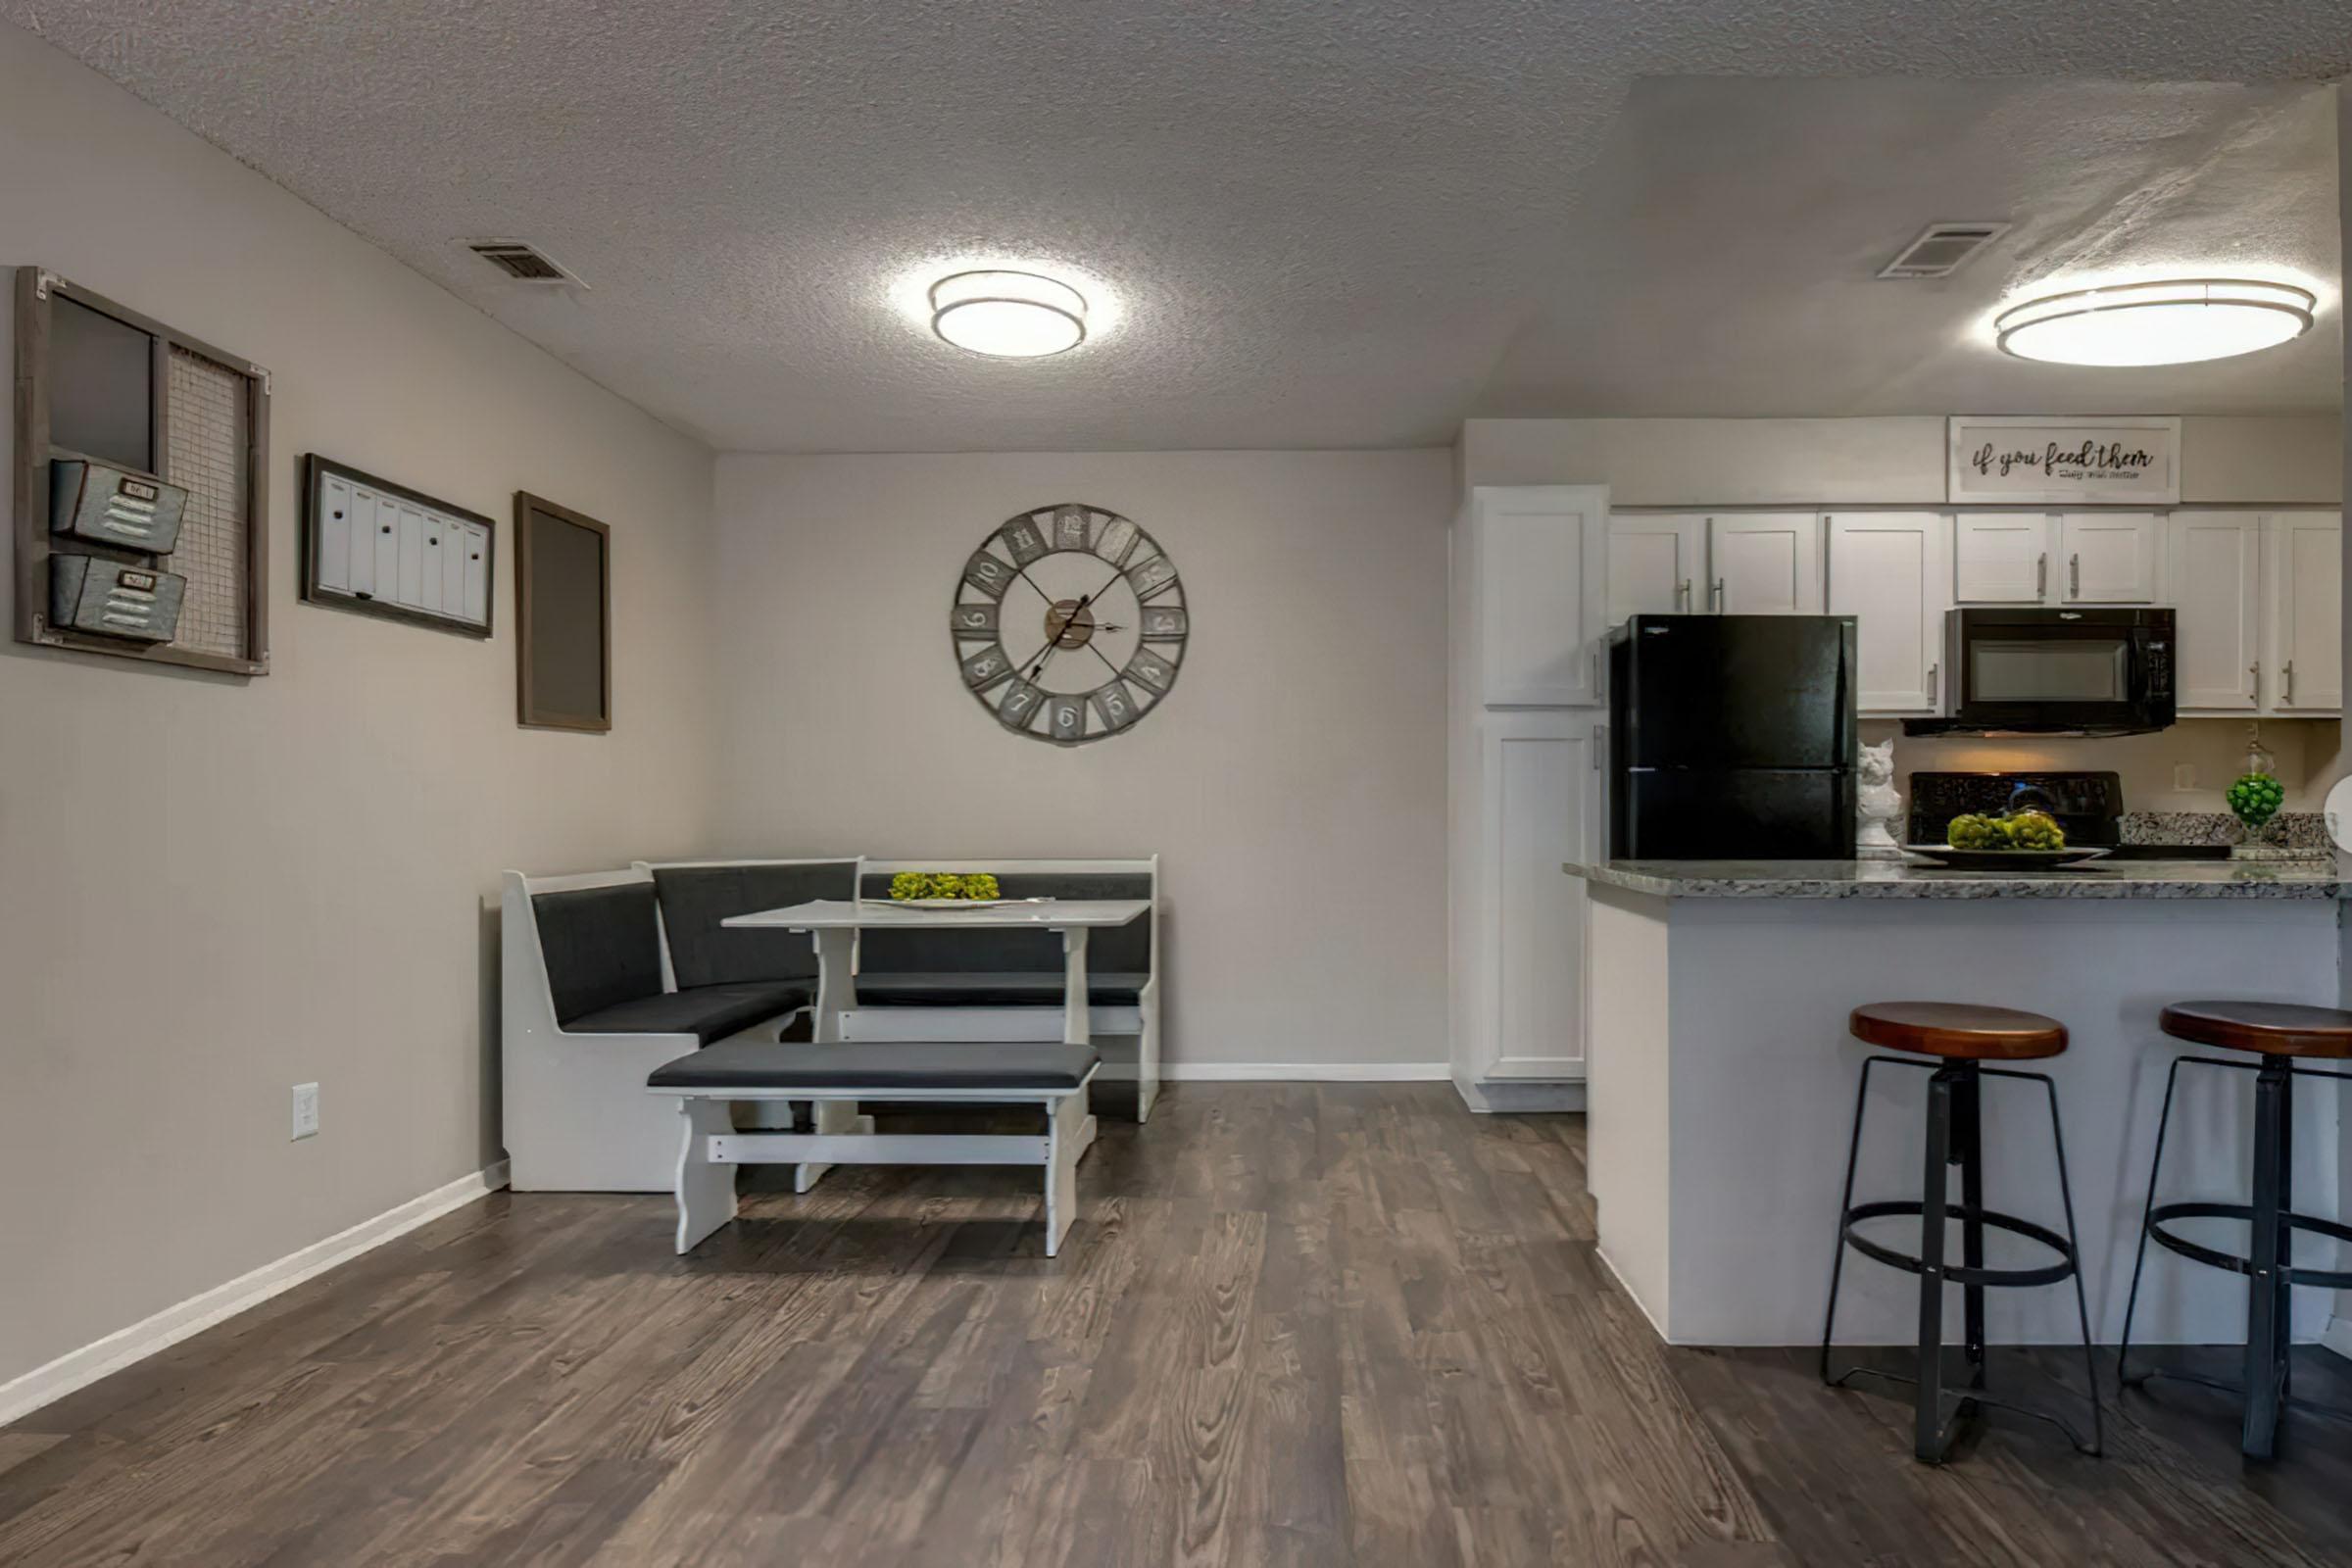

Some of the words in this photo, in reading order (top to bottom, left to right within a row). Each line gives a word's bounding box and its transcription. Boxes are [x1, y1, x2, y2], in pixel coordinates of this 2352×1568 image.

[1999, 451, 2042, 477] you
[2044, 440, 2095, 477] feed
[2096, 442, 2154, 470] them
[977, 562, 1000, 584] 10
[962, 612, 986, 627] 9
[1140, 664, 1161, 681] 4
[1009, 693, 1030, 712] 7
[1107, 693, 1126, 716] 5
[1057, 707, 1078, 728] 6
